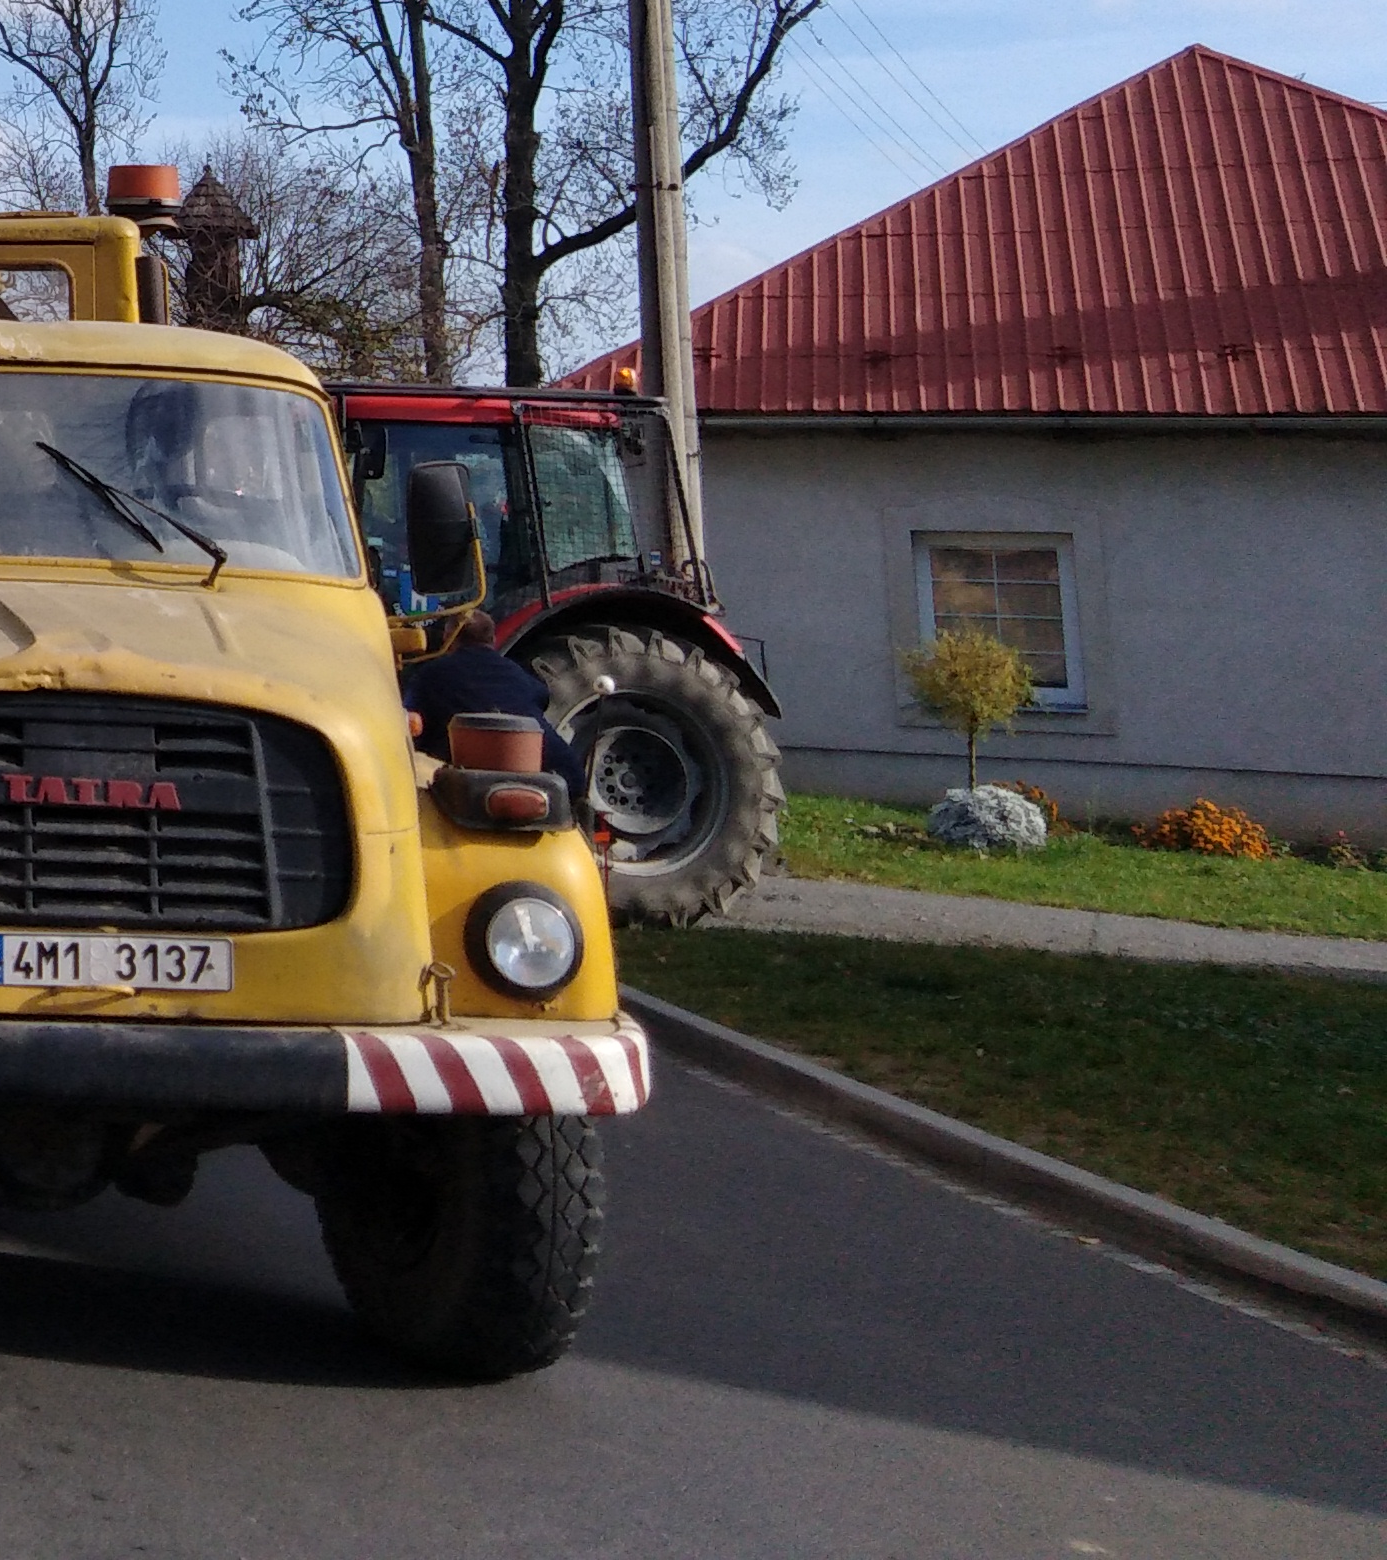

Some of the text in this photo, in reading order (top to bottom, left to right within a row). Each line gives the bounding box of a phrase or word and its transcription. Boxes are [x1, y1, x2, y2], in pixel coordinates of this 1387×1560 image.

[2, 774, 182, 810] TATRA
[13, 941, 211, 983] 4M1 3137
